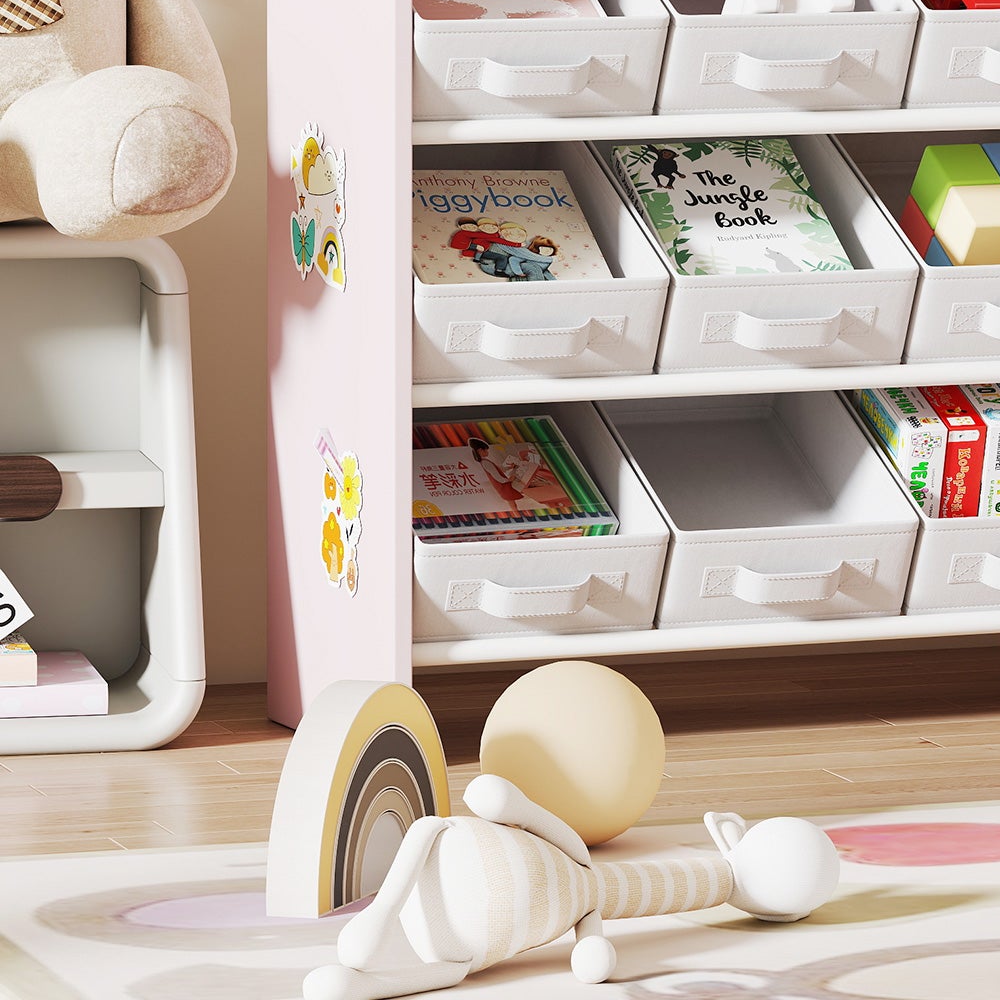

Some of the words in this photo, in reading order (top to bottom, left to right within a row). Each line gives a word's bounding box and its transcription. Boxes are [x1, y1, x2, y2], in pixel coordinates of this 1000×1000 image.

[482, 175, 550, 187] Browne
[692, 170, 736, 187] The
[412, 187, 574, 214] iggybook
[684, 185, 768, 211] Jungle
[714, 208, 778, 228] Book
[756, 232, 788, 240] Kipling
